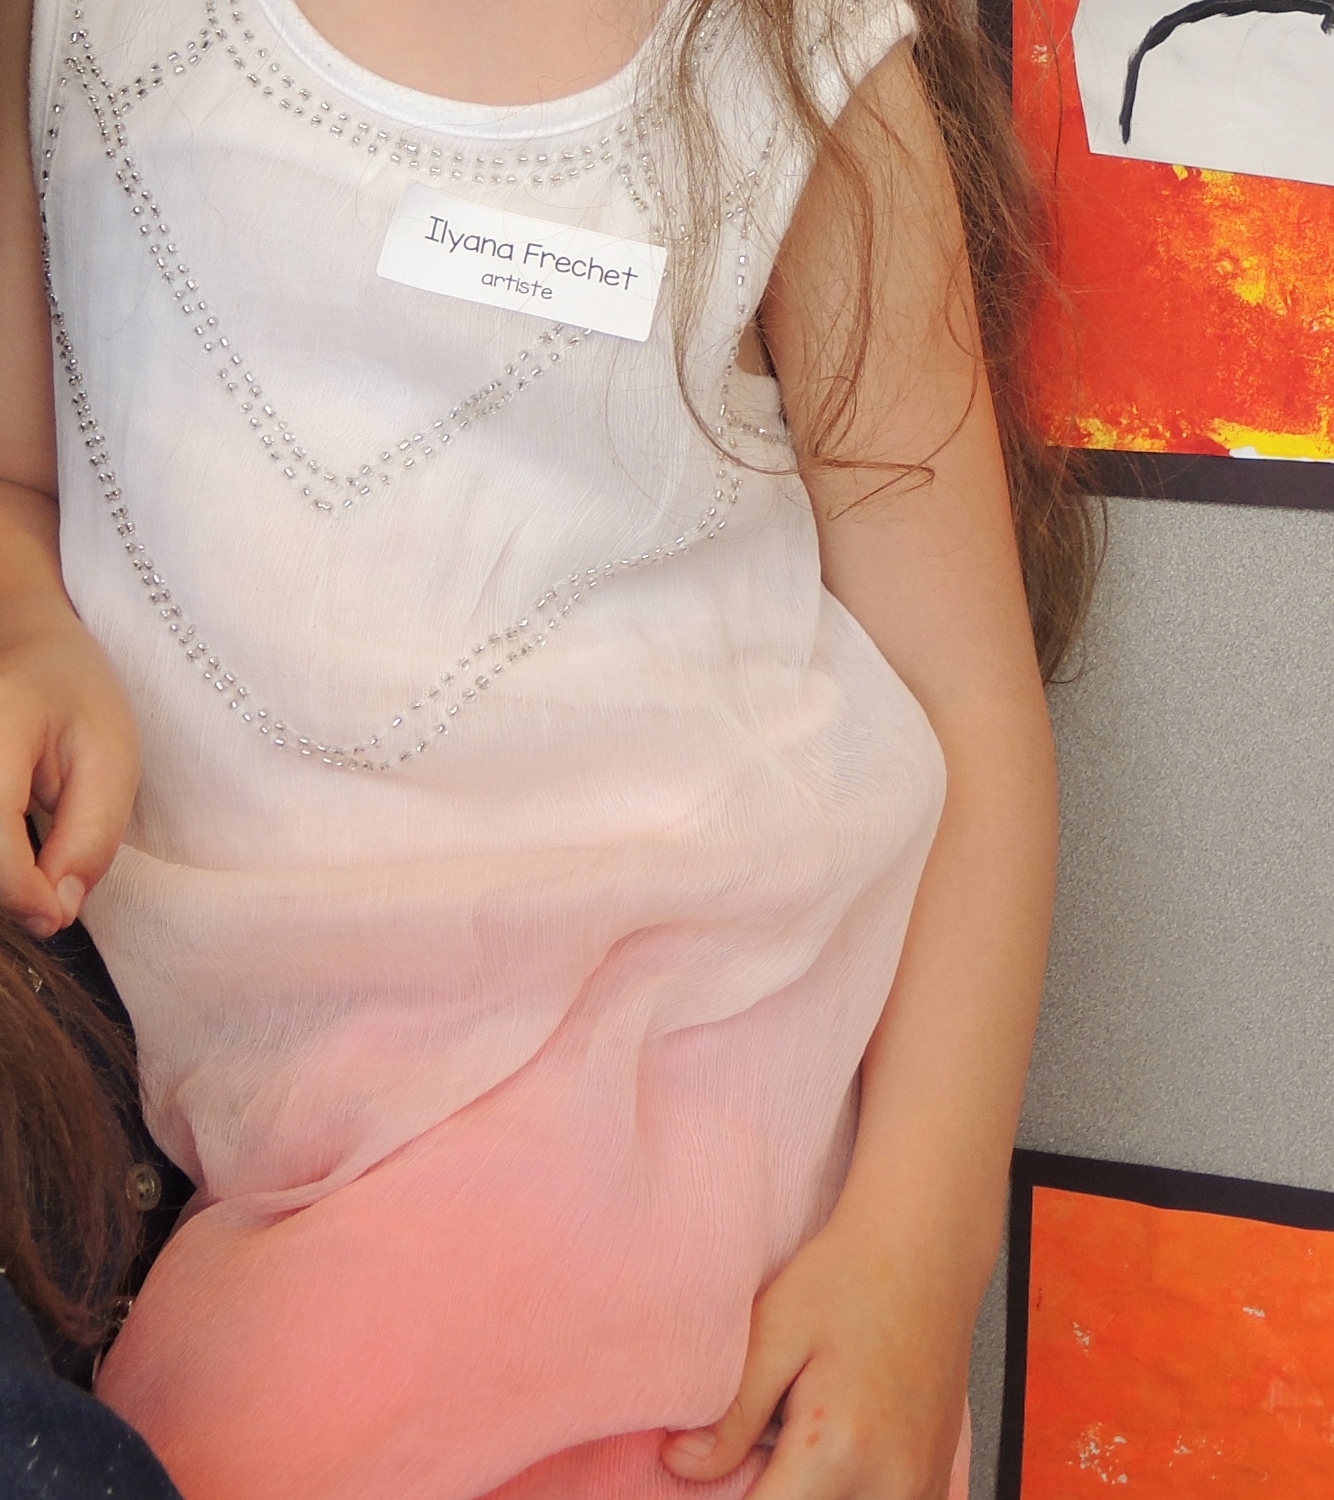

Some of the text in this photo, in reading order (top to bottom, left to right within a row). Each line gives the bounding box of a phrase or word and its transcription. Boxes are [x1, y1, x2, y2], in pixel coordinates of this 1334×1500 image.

[424, 215, 638, 291] Ilyana Frechet
[481, 271, 553, 300] artiste
